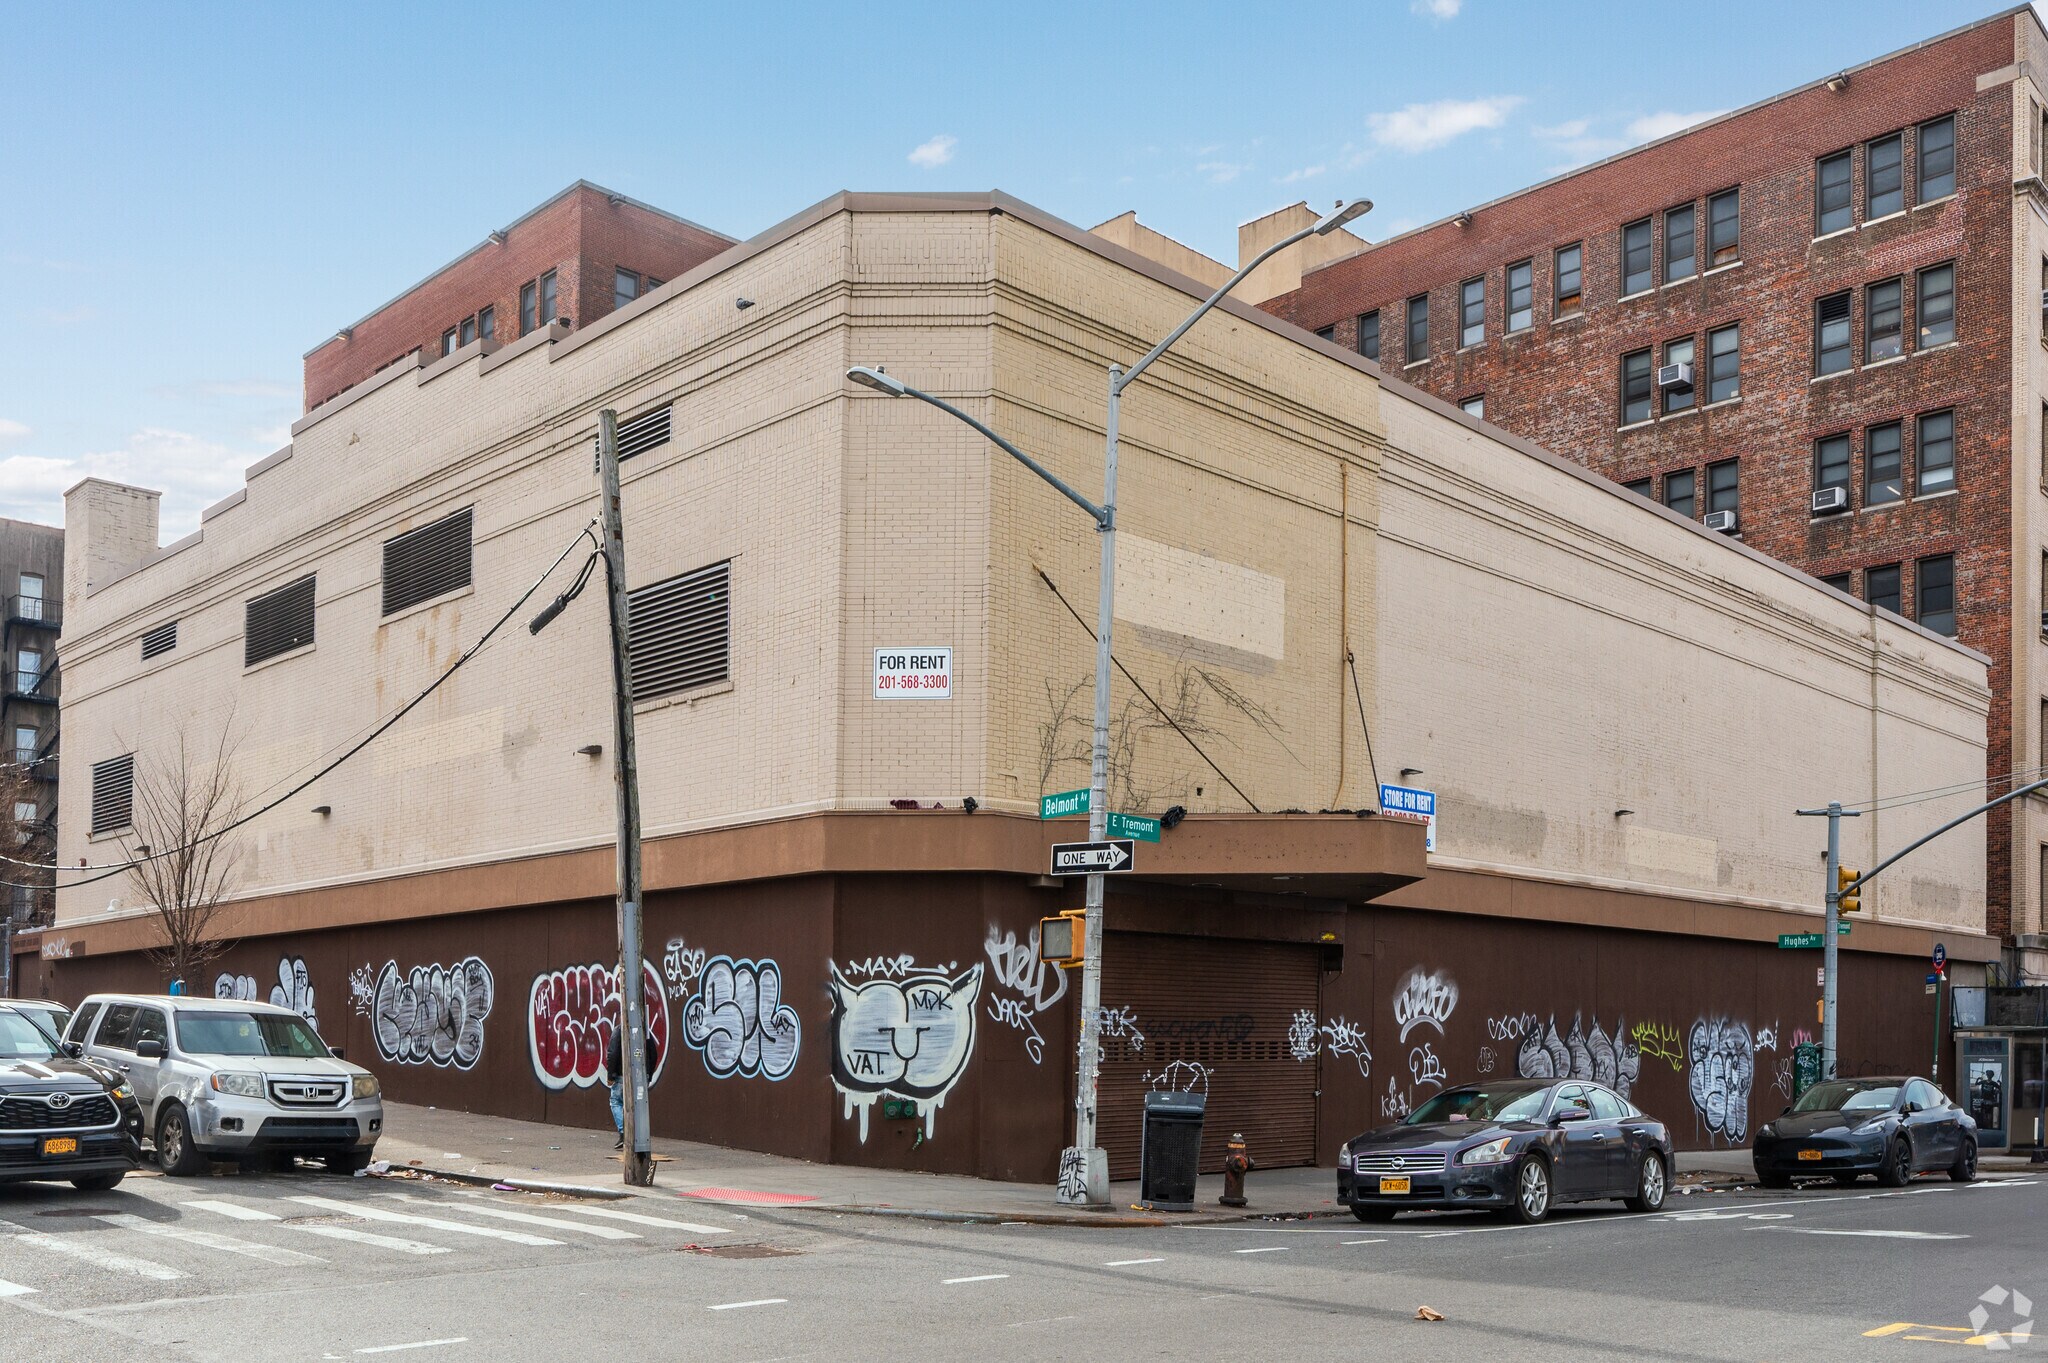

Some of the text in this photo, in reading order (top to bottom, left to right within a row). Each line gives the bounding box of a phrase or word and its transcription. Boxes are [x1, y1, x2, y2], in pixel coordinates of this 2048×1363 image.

[879, 655, 947, 670] FOR RENT
[878, 674, 948, 690] 201-568-3300
[1045, 791, 1088, 816] Belmont Av
[1384, 788, 1432, 812] STORE FOR RENT
[1112, 815, 1154, 833] E Tremont
[1063, 850, 1121, 865] ONE WAY
[1784, 935, 1809, 948] Hughes
